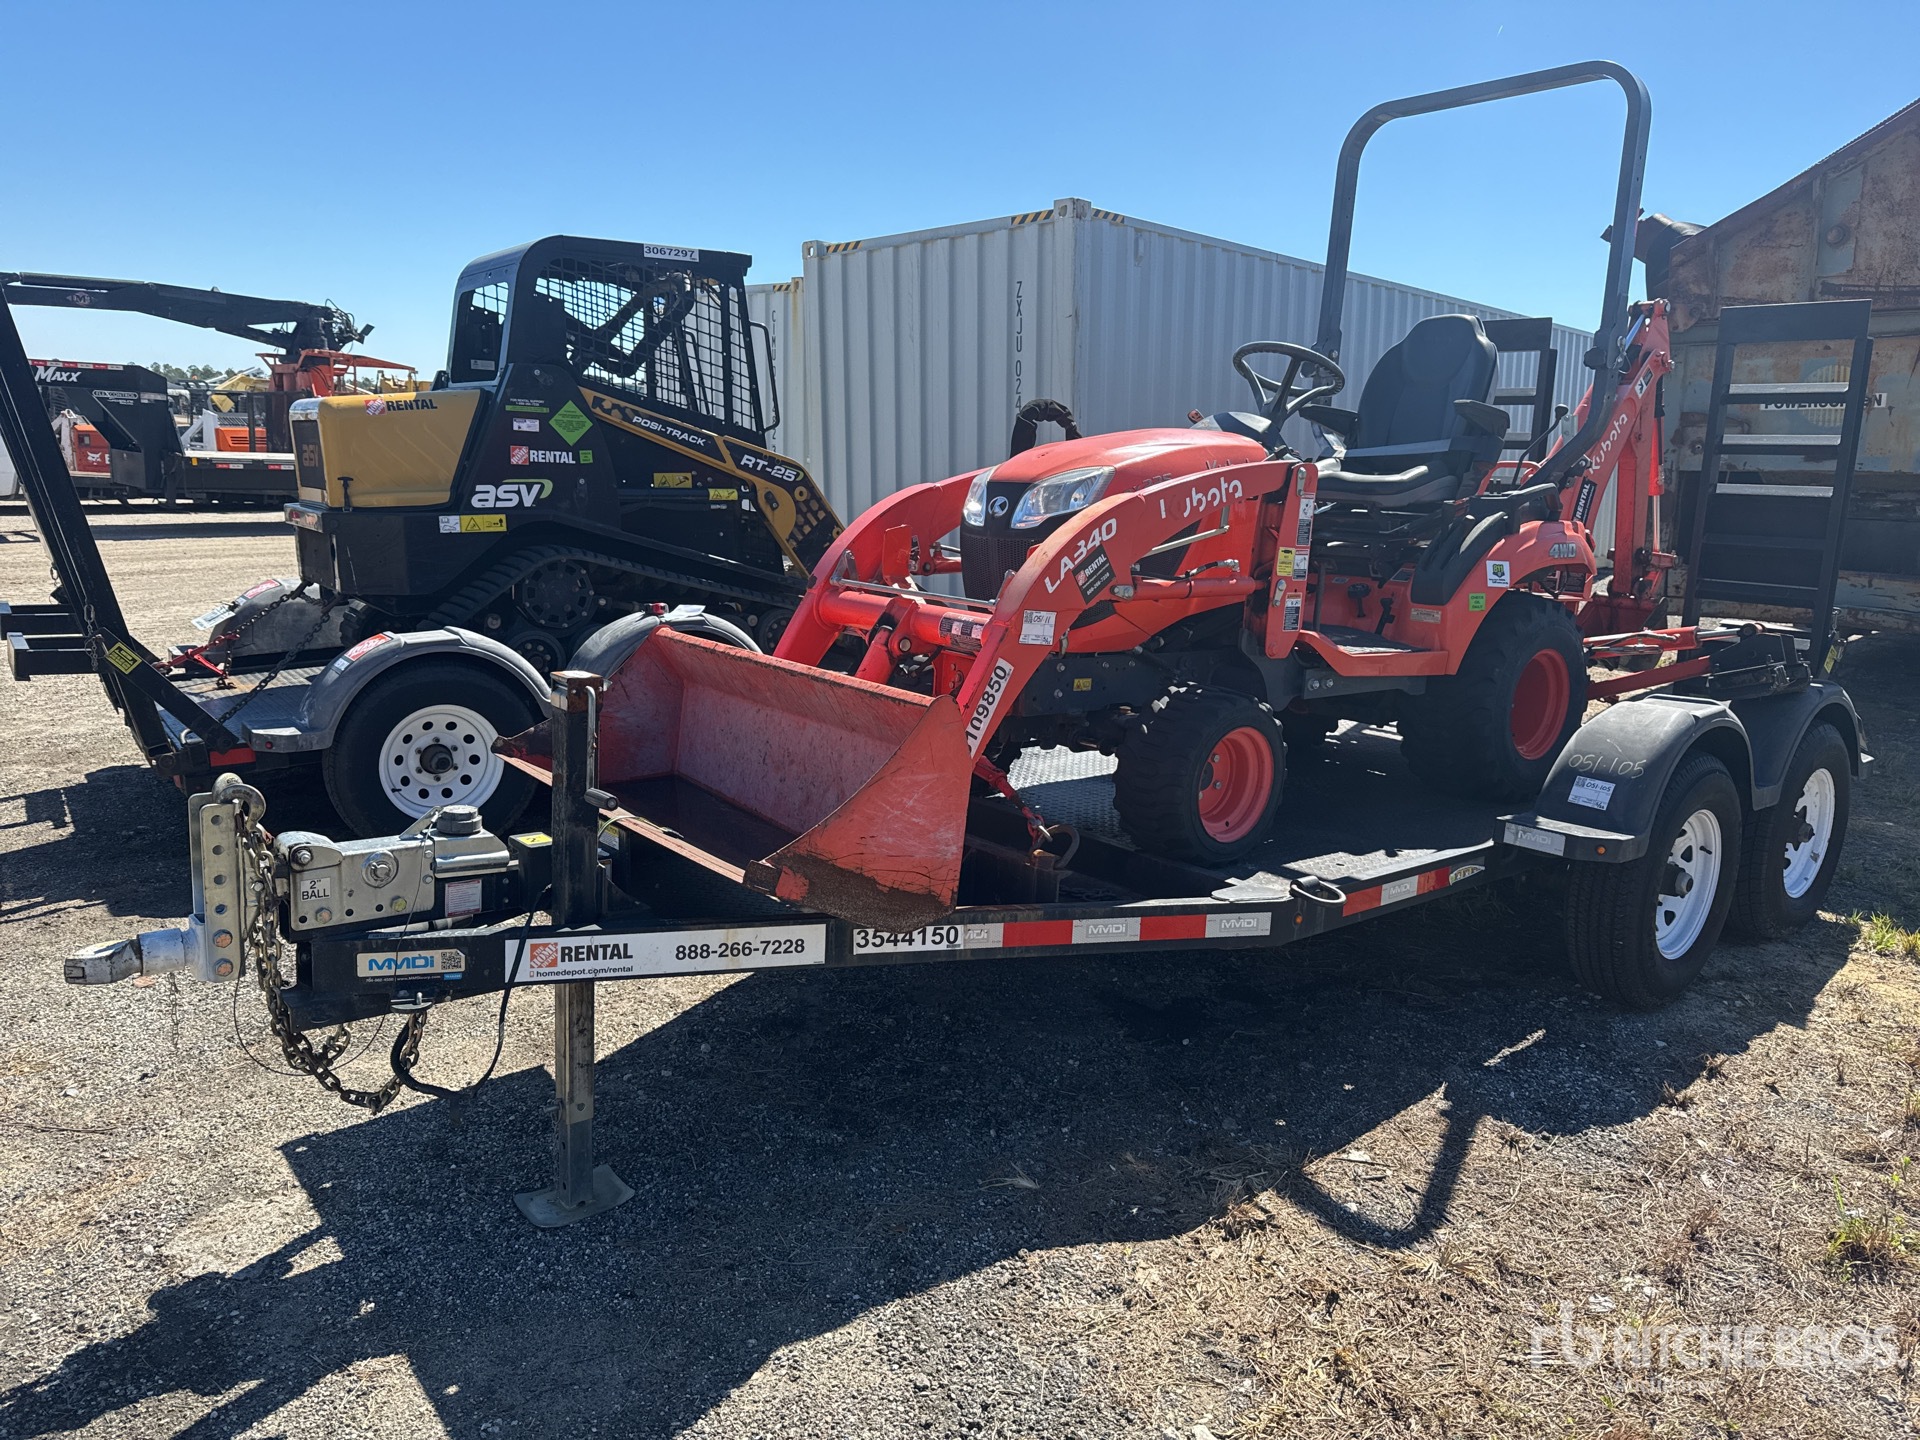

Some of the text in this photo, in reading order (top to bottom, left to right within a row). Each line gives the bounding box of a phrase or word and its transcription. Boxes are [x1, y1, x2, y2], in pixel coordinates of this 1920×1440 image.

[645, 246, 695, 258] 3067297
[387, 399, 438, 412] RENTAL
[632, 415, 706, 447] POSI-TRACK
[1588, 413, 1628, 474] Kubota
[529, 450, 576, 464] RENTAL
[740, 454, 797, 482] RT-25
[1575, 483, 1591, 519] RENTAL
[1044, 518, 1117, 594] LA340
[1549, 543, 1577, 558] 4WD
[1084, 554, 1107, 577] RENTAL
[965, 665, 1007, 752] 109850
[301, 888, 330, 900] BALL
[856, 926, 959, 949] 3544150
[530, 943, 558, 969] HOME
[560, 943, 633, 963] RENTAL
[675, 938, 805, 961] 888-266-7228
[536, 966, 633, 978] homedepot.com/rental
